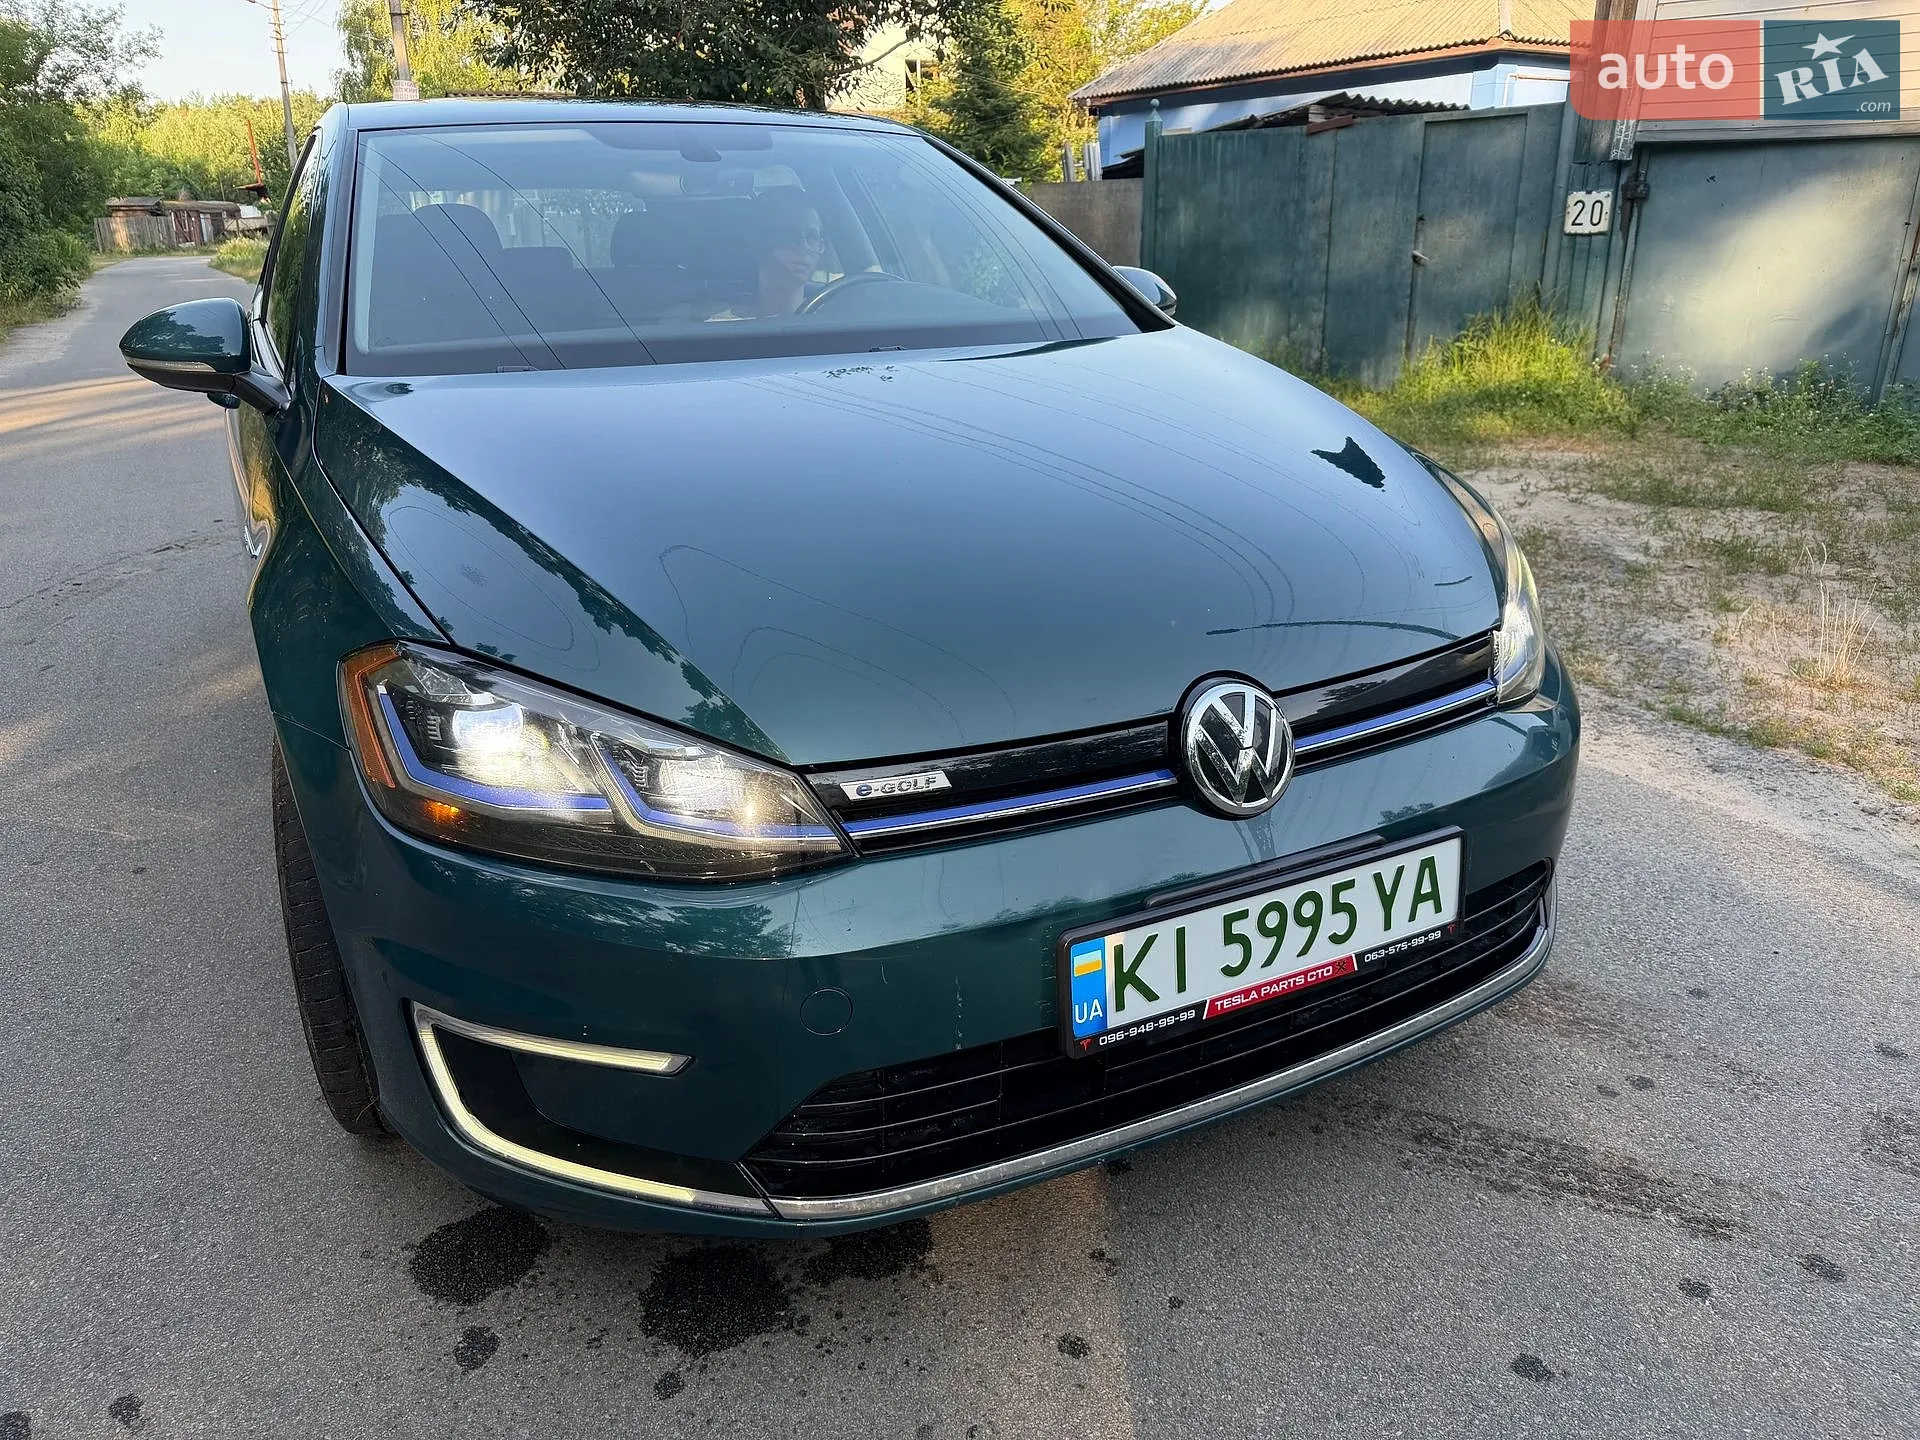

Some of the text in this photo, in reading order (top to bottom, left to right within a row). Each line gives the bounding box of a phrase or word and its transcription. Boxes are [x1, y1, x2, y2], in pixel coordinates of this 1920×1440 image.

[1571, 199, 1604, 227] 20
[855, 776, 937, 797] e-GOLF
[1113, 855, 1443, 1013] KI 5995 YA
[1364, 930, 1442, 964] 063-575-99-99
[1215, 988, 1259, 1012] TESLA
[1260, 975, 1305, 998] PARTS
[1074, 998, 1103, 1024] UA
[1098, 1009, 1196, 1047] 096-948-99-99
